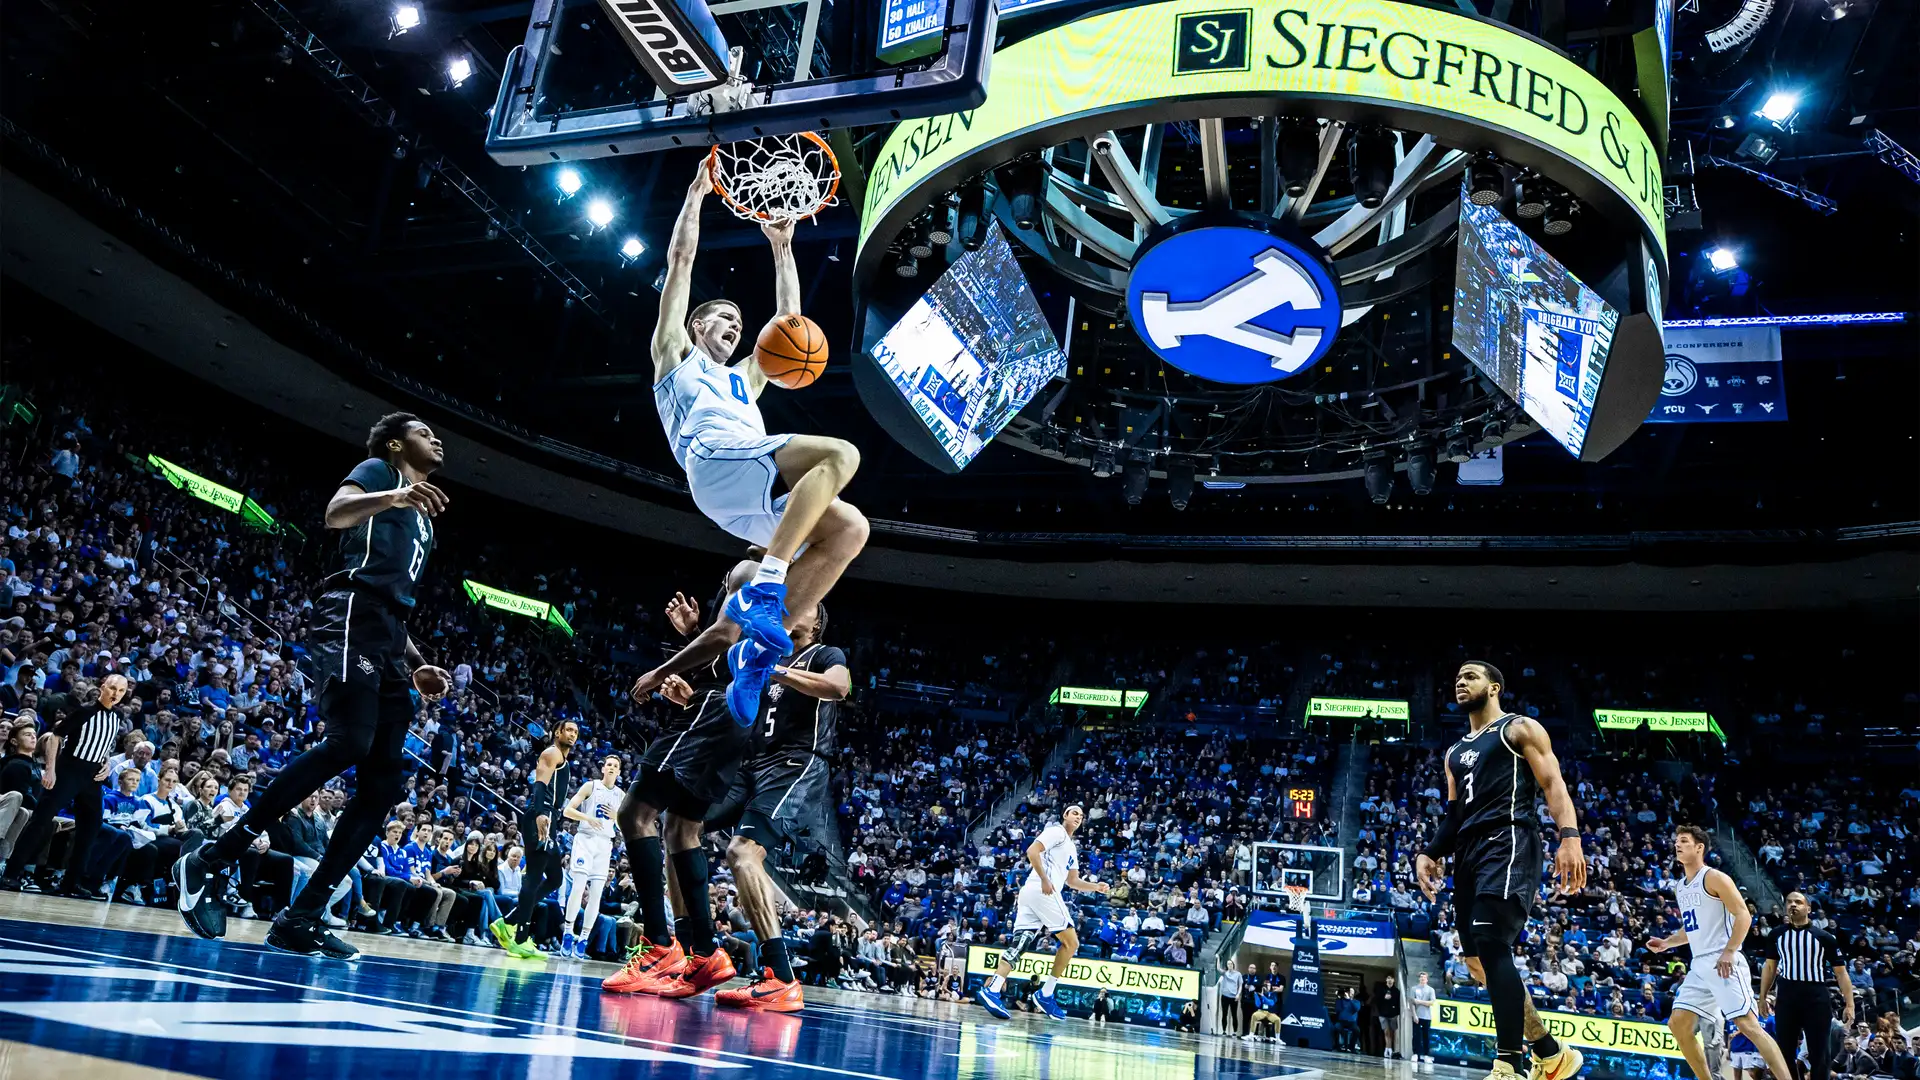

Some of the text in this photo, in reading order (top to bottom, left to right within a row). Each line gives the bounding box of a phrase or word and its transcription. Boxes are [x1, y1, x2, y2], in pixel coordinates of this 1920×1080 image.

[906, 1, 926, 18] HALL
[904, 14, 938, 35] KHALIFA
[1266, 9, 1589, 136] SIEGFRIED
[1600, 111, 1635, 184] &
[1142, 245, 1325, 373] Y
[1538, 311, 1576, 331] BRIGHAM
[1676, 341, 1744, 350] CONFERENCE
[730, 372, 749, 404] 0
[1663, 405, 1686, 414] TCU
[408, 538, 425, 582] 13
[1324, 702, 1365, 713] SIEGFRIED
[1376, 704, 1406, 714] JENSEN
[764, 706, 777, 737] 5
[1670, 716, 1705, 726] JENSEN
[1290, 789, 1314, 801] 15:23
[1463, 771, 1475, 805] 3
[1295, 802, 1311, 818] 14
[1683, 908, 1699, 933] 21
[1096, 965, 1113, 984] &
[1118, 966, 1184, 992] JENSEN
[1582, 1021, 1600, 1042] &
[1608, 1022, 1680, 1050] JENSE
